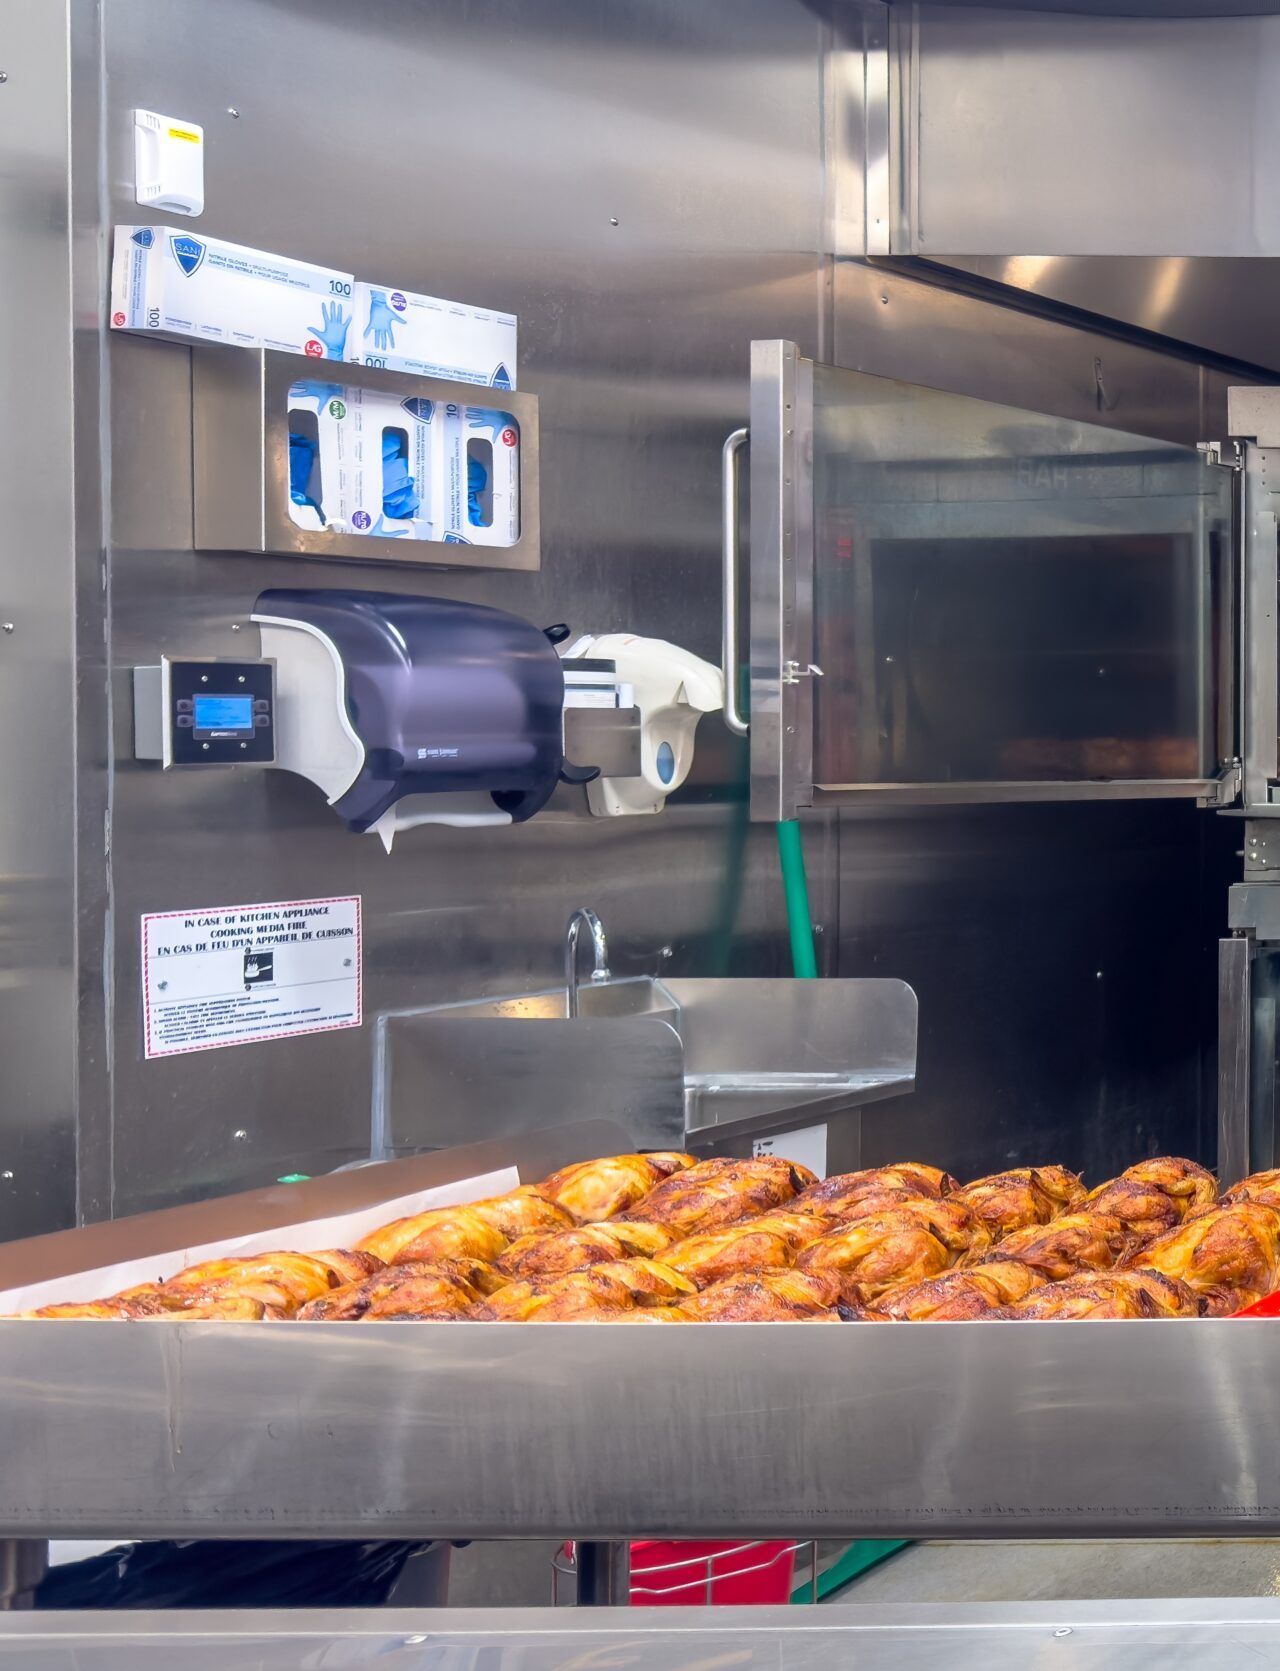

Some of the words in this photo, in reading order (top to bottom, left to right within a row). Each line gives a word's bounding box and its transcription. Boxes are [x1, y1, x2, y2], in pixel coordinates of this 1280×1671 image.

[329, 280, 351, 295] 100
[149, 307, 159, 328] 100
[184, 919, 195, 928] IN
[197, 916, 222, 927] CASE
[225, 914, 236, 924] OF
[239, 911, 280, 923] KITCHEN
[282, 907, 329, 919] APPLIANCE
[210, 926, 253, 939] COOKING
[256, 923, 286, 934] MEDIA
[287, 921, 307, 931] FIRE
[158, 947, 171, 956] EN
[173, 944, 192, 954] CAS
[195, 943, 209, 952] DE
[211, 941, 229, 951] FEU
[232, 938, 253, 948] D'UN
[255, 934, 298, 946] APPAREIL
[301, 932, 314, 942] DE
[316, 927, 353, 938] CUISSON
